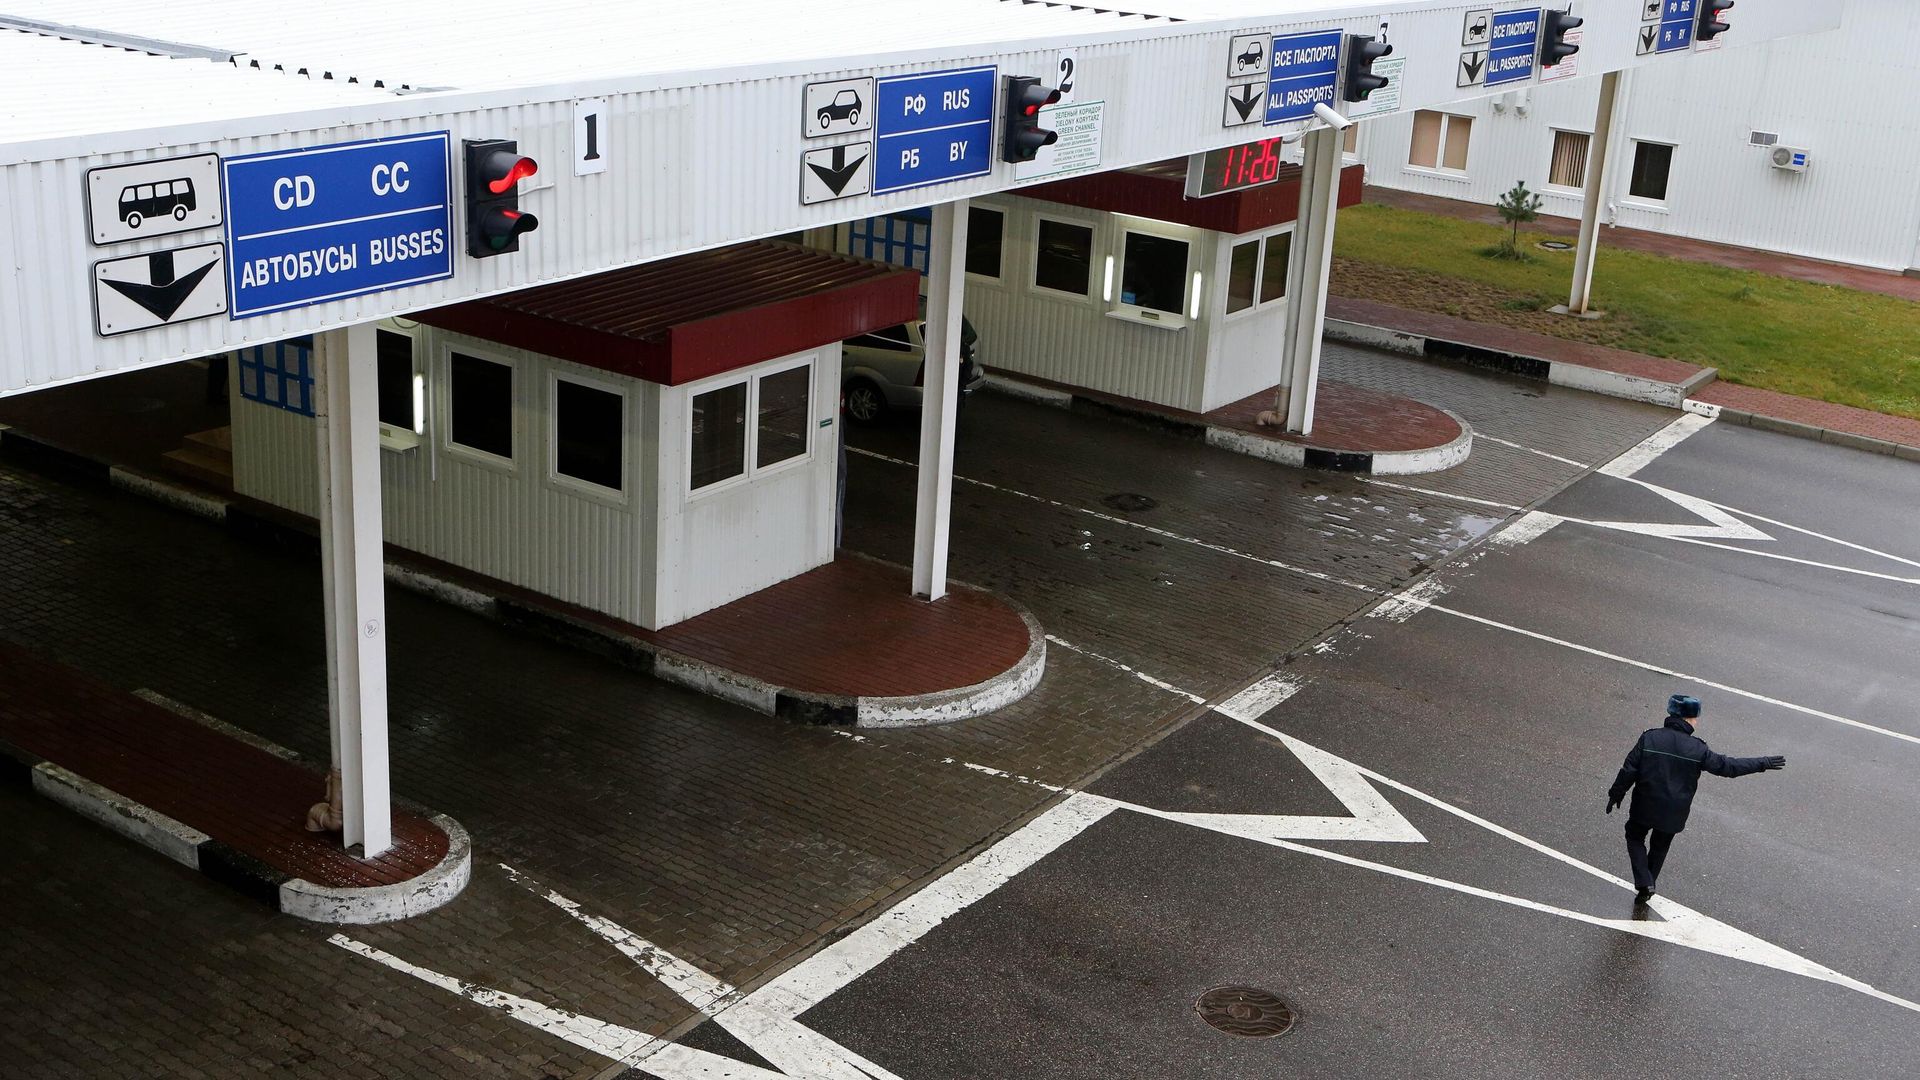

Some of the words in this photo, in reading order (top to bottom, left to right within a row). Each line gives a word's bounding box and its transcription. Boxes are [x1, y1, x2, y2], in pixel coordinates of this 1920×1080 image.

[1492, 24, 1506, 39] ВСЕ
[1506, 20, 1536, 37] ПАСПОРТА
[1274, 50, 1292, 67] ВСЕ
[1293, 45, 1337, 65] ПАСПОРТА
[1487, 59, 1500, 73] ALL
[1500, 54, 1533, 71] PASSPORTS
[1059, 57, 1074, 93] 2
[904, 93, 927, 117] РФ
[942, 88, 970, 111] RUS
[1269, 92, 1286, 109] ALL
[1286, 84, 1334, 106] PASSPORTS
[1058, 127, 1074, 135] GREEN
[1075, 124, 1096, 132] CHANNEL
[1076, 115, 1100, 124] KORYTARZ
[583, 113, 601, 161] 1
[900, 148, 920, 170] РБ
[949, 140, 968, 162] BY
[1223, 137, 1280, 187] 11:26
[371, 161, 410, 196] CC
[273, 174, 316, 211] CD
[370, 228, 445, 265] BUSSES
[241, 243, 358, 289] АВТОБУСЫ
